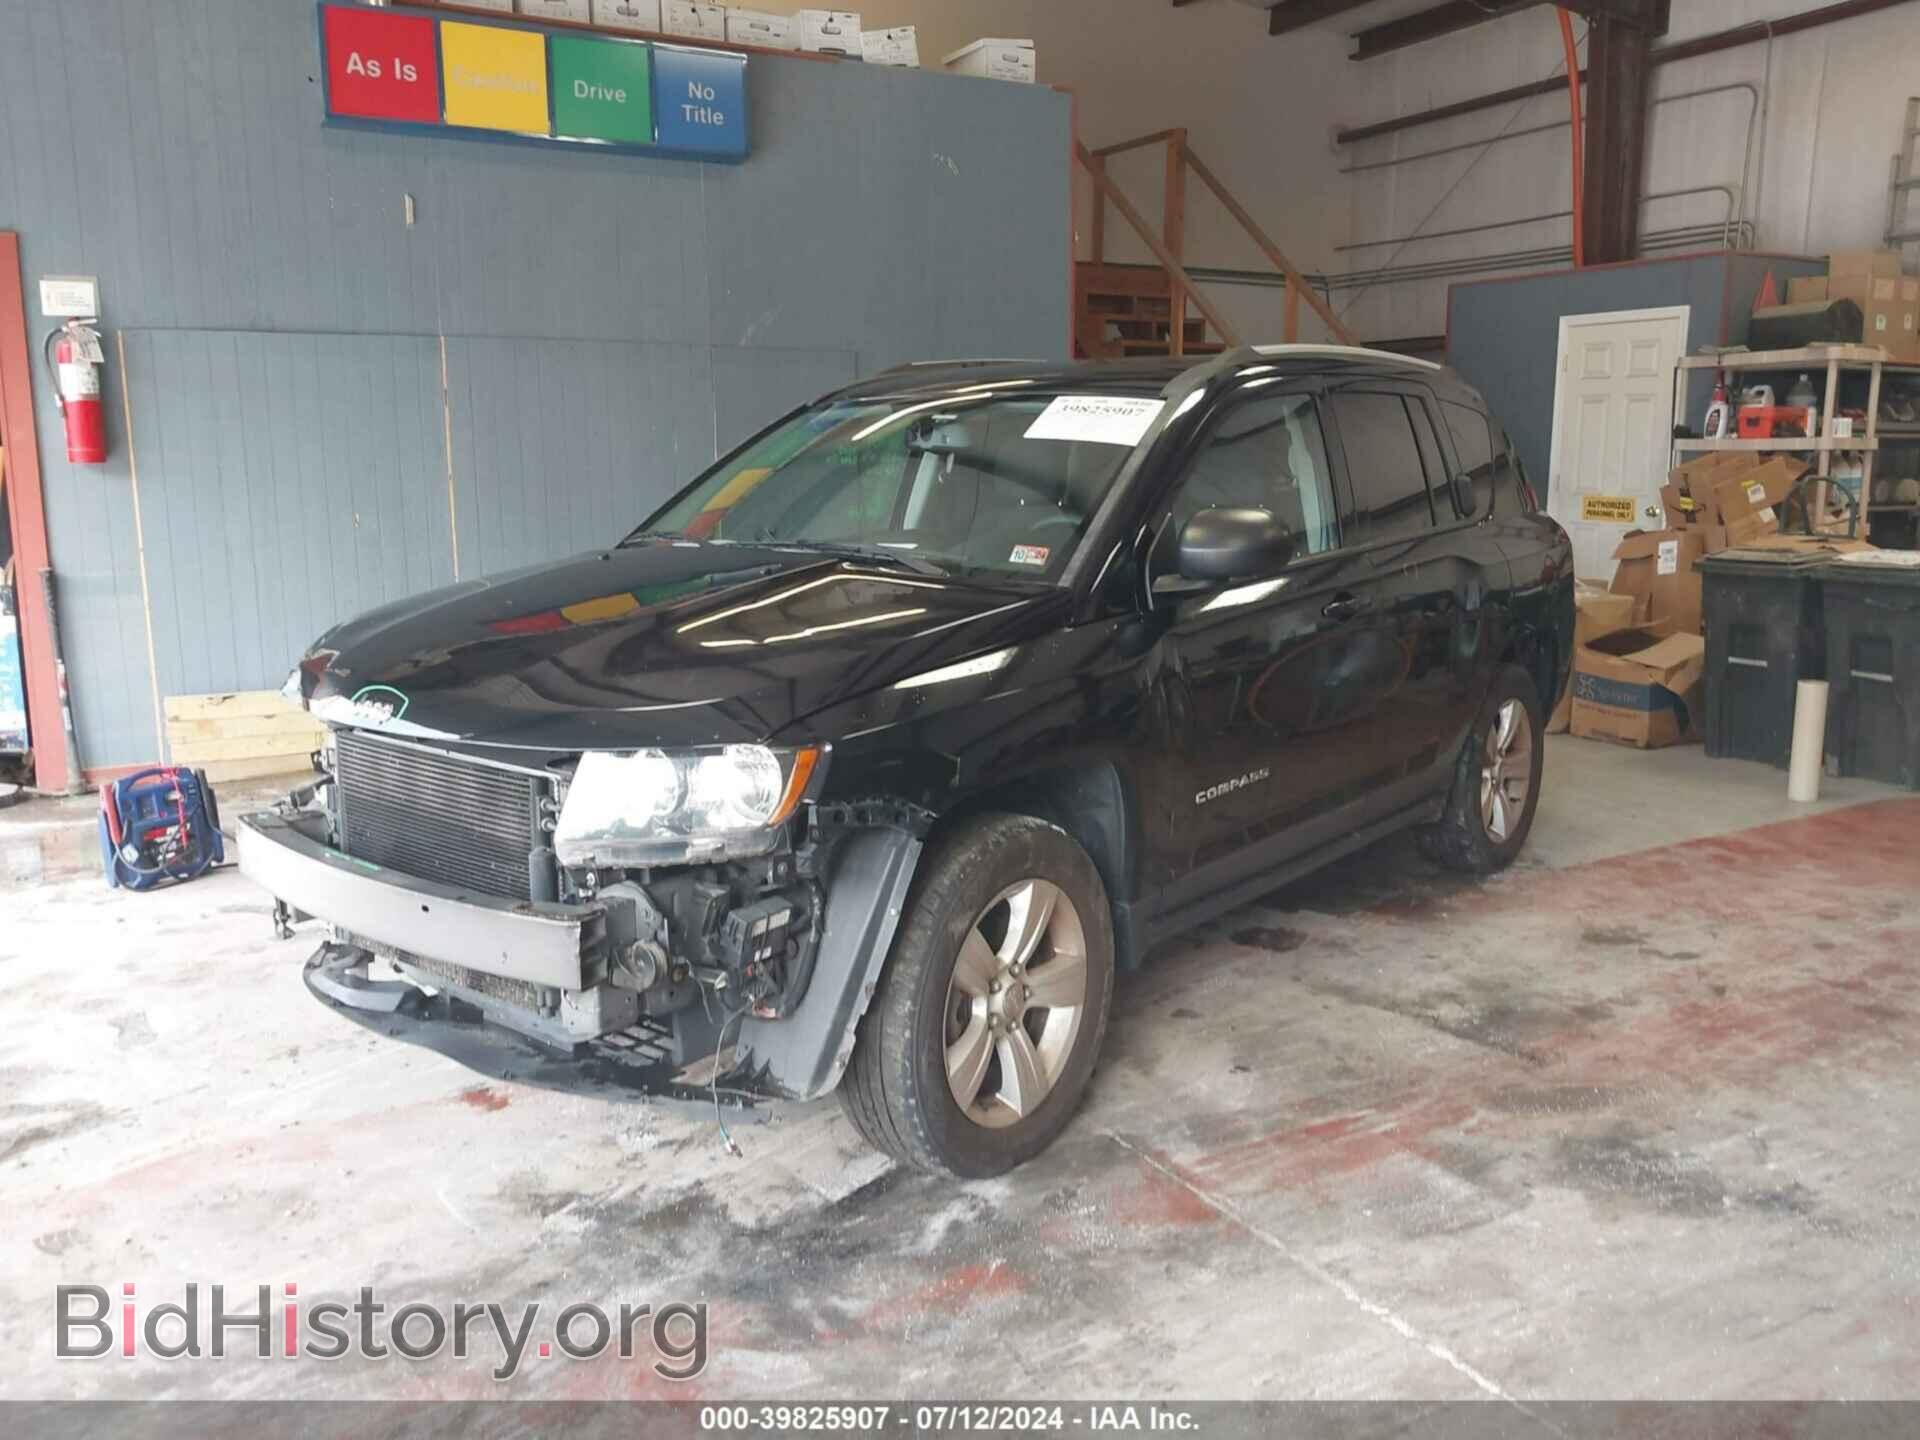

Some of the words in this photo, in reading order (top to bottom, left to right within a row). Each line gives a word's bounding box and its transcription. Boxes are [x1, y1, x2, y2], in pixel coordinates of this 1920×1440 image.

[346, 51, 382, 78] As
[394, 57, 418, 82] Is
[573, 79, 627, 103] Drive
[688, 81, 716, 101] No
[681, 104, 725, 125] Title
[1195, 767, 1270, 805] COMPASS
